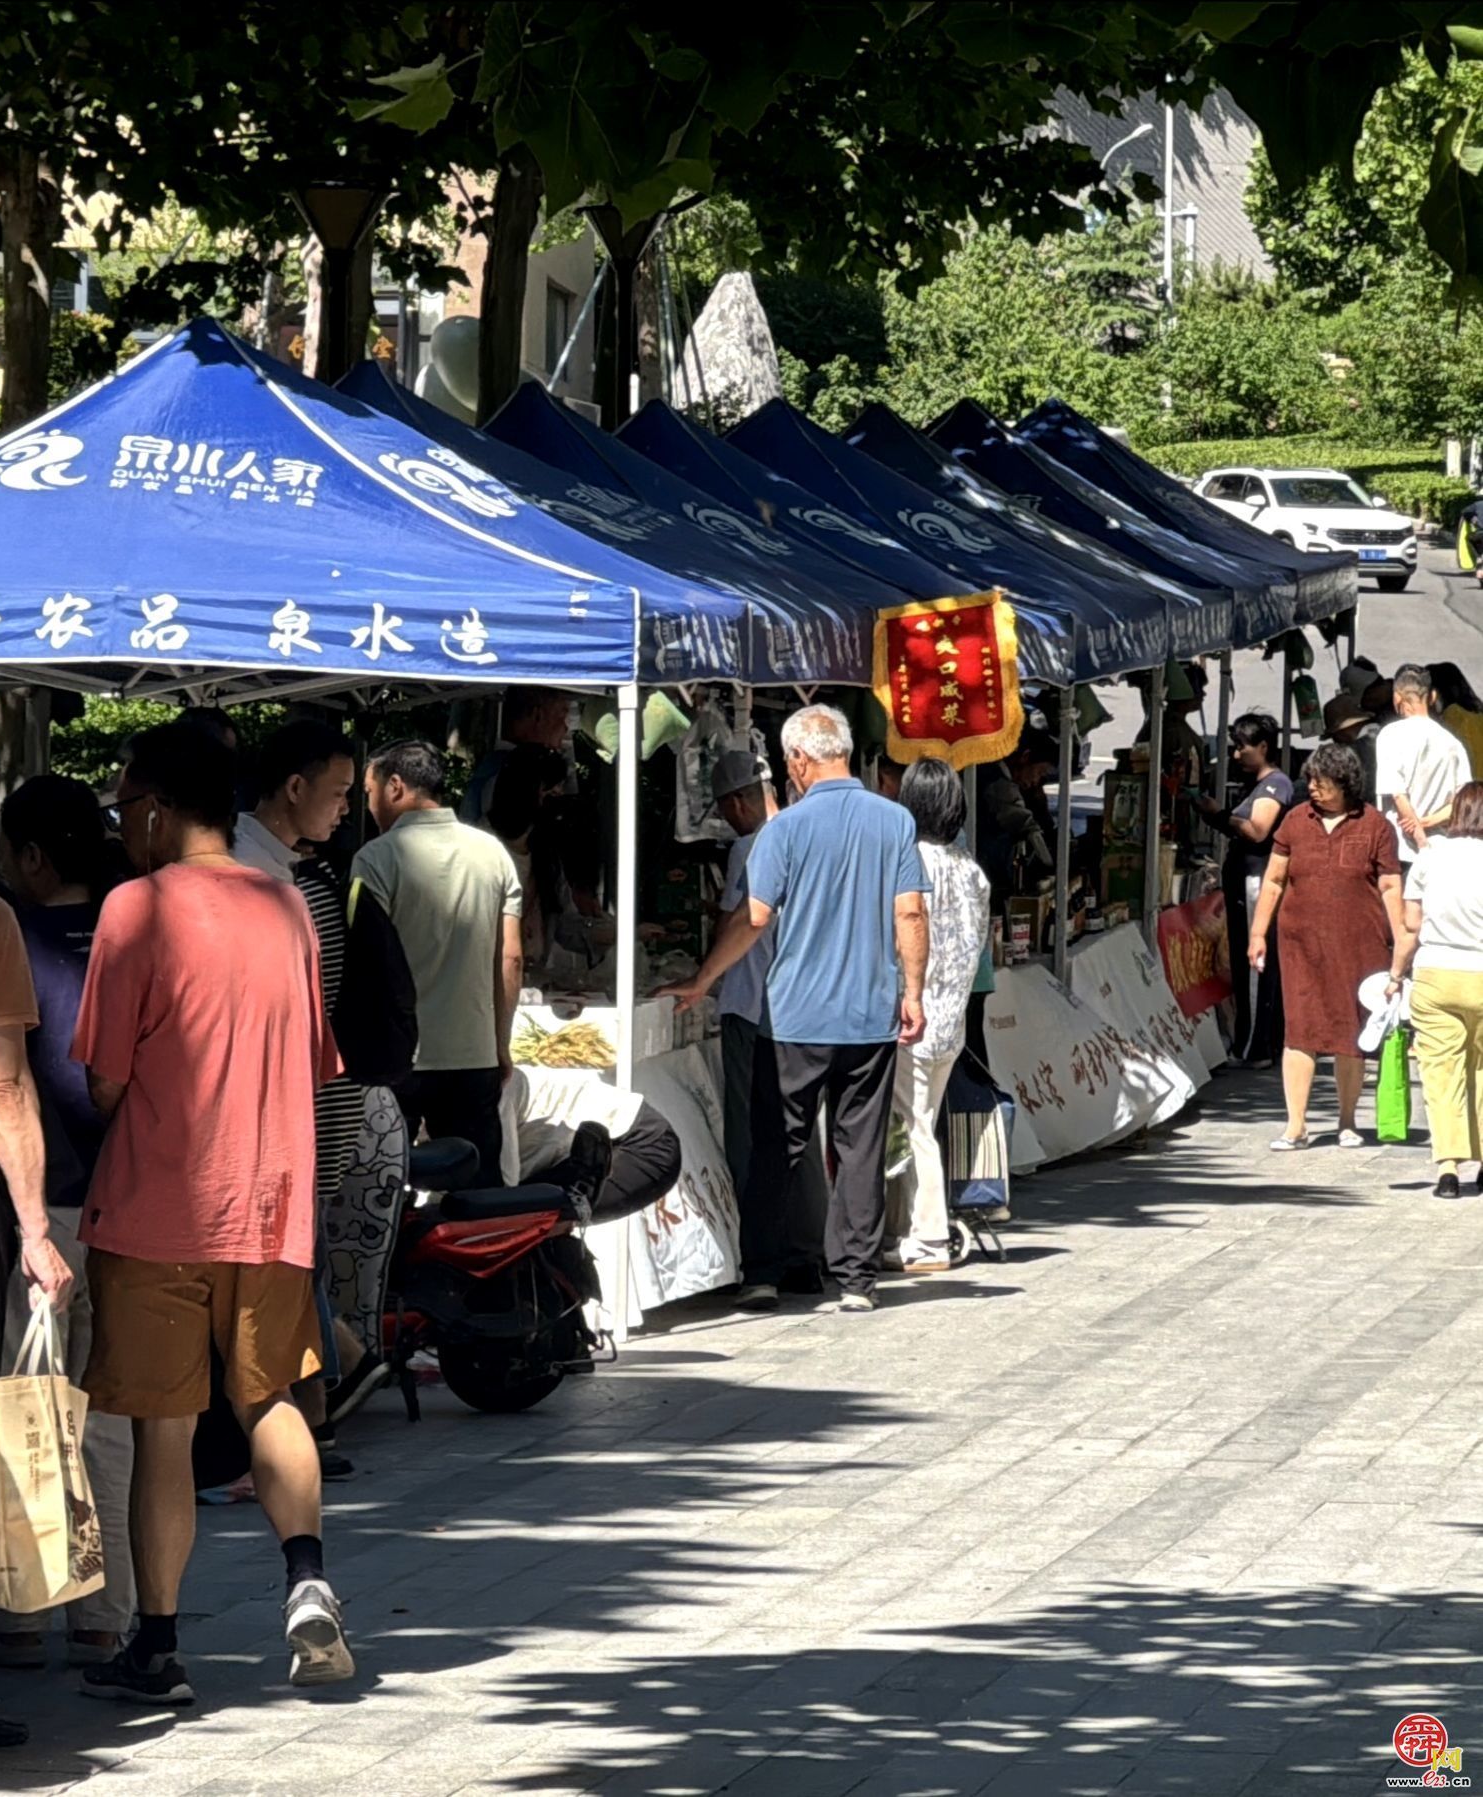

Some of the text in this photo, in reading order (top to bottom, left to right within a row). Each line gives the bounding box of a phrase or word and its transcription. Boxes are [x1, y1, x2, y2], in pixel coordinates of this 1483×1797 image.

[112, 468, 316, 499] QUAN SHUI REN JIA
[115, 435, 324, 488] 泉水人家
[267, 599, 498, 665] 泉水造
